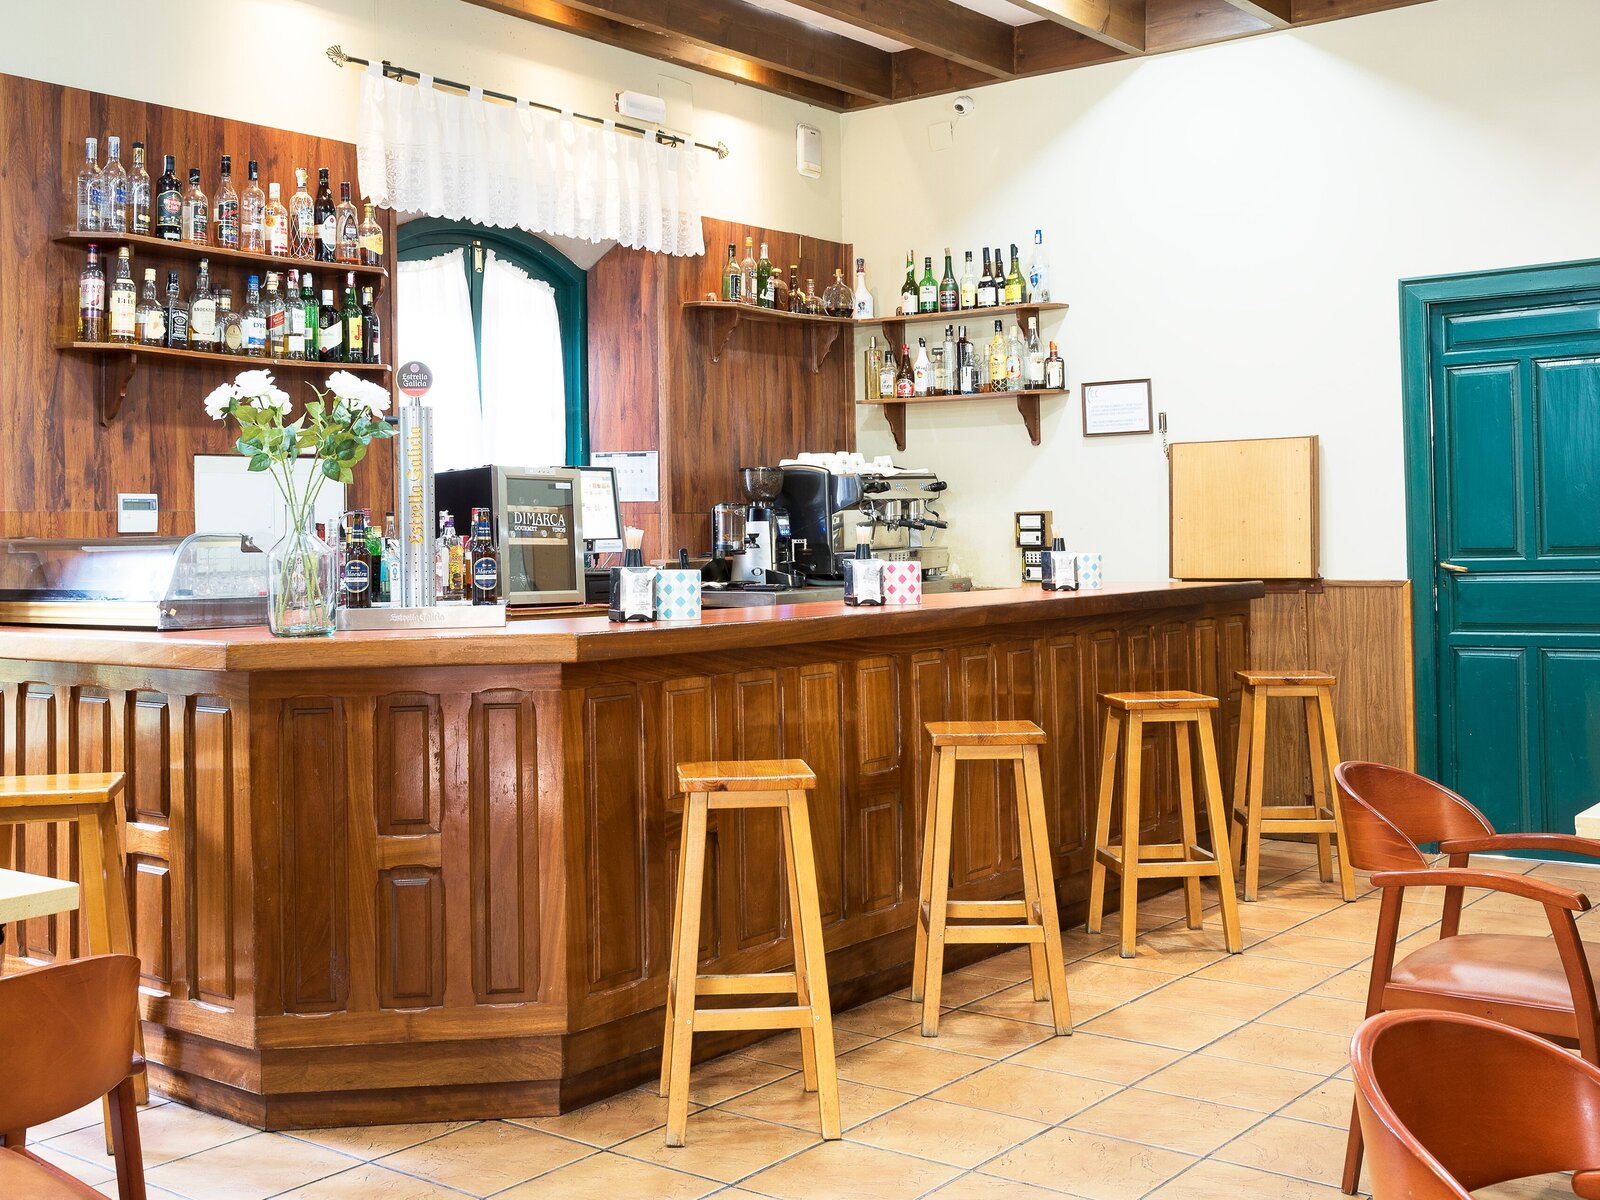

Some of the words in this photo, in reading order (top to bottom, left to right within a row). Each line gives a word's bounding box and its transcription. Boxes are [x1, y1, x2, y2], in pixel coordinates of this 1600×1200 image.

[402, 372, 428, 382] Estrella
[402, 379, 427, 387] Galicia
[406, 426, 423, 481] Galicia
[408, 485, 425, 545] Estrella
[514, 511, 566, 527] DIMARCA
